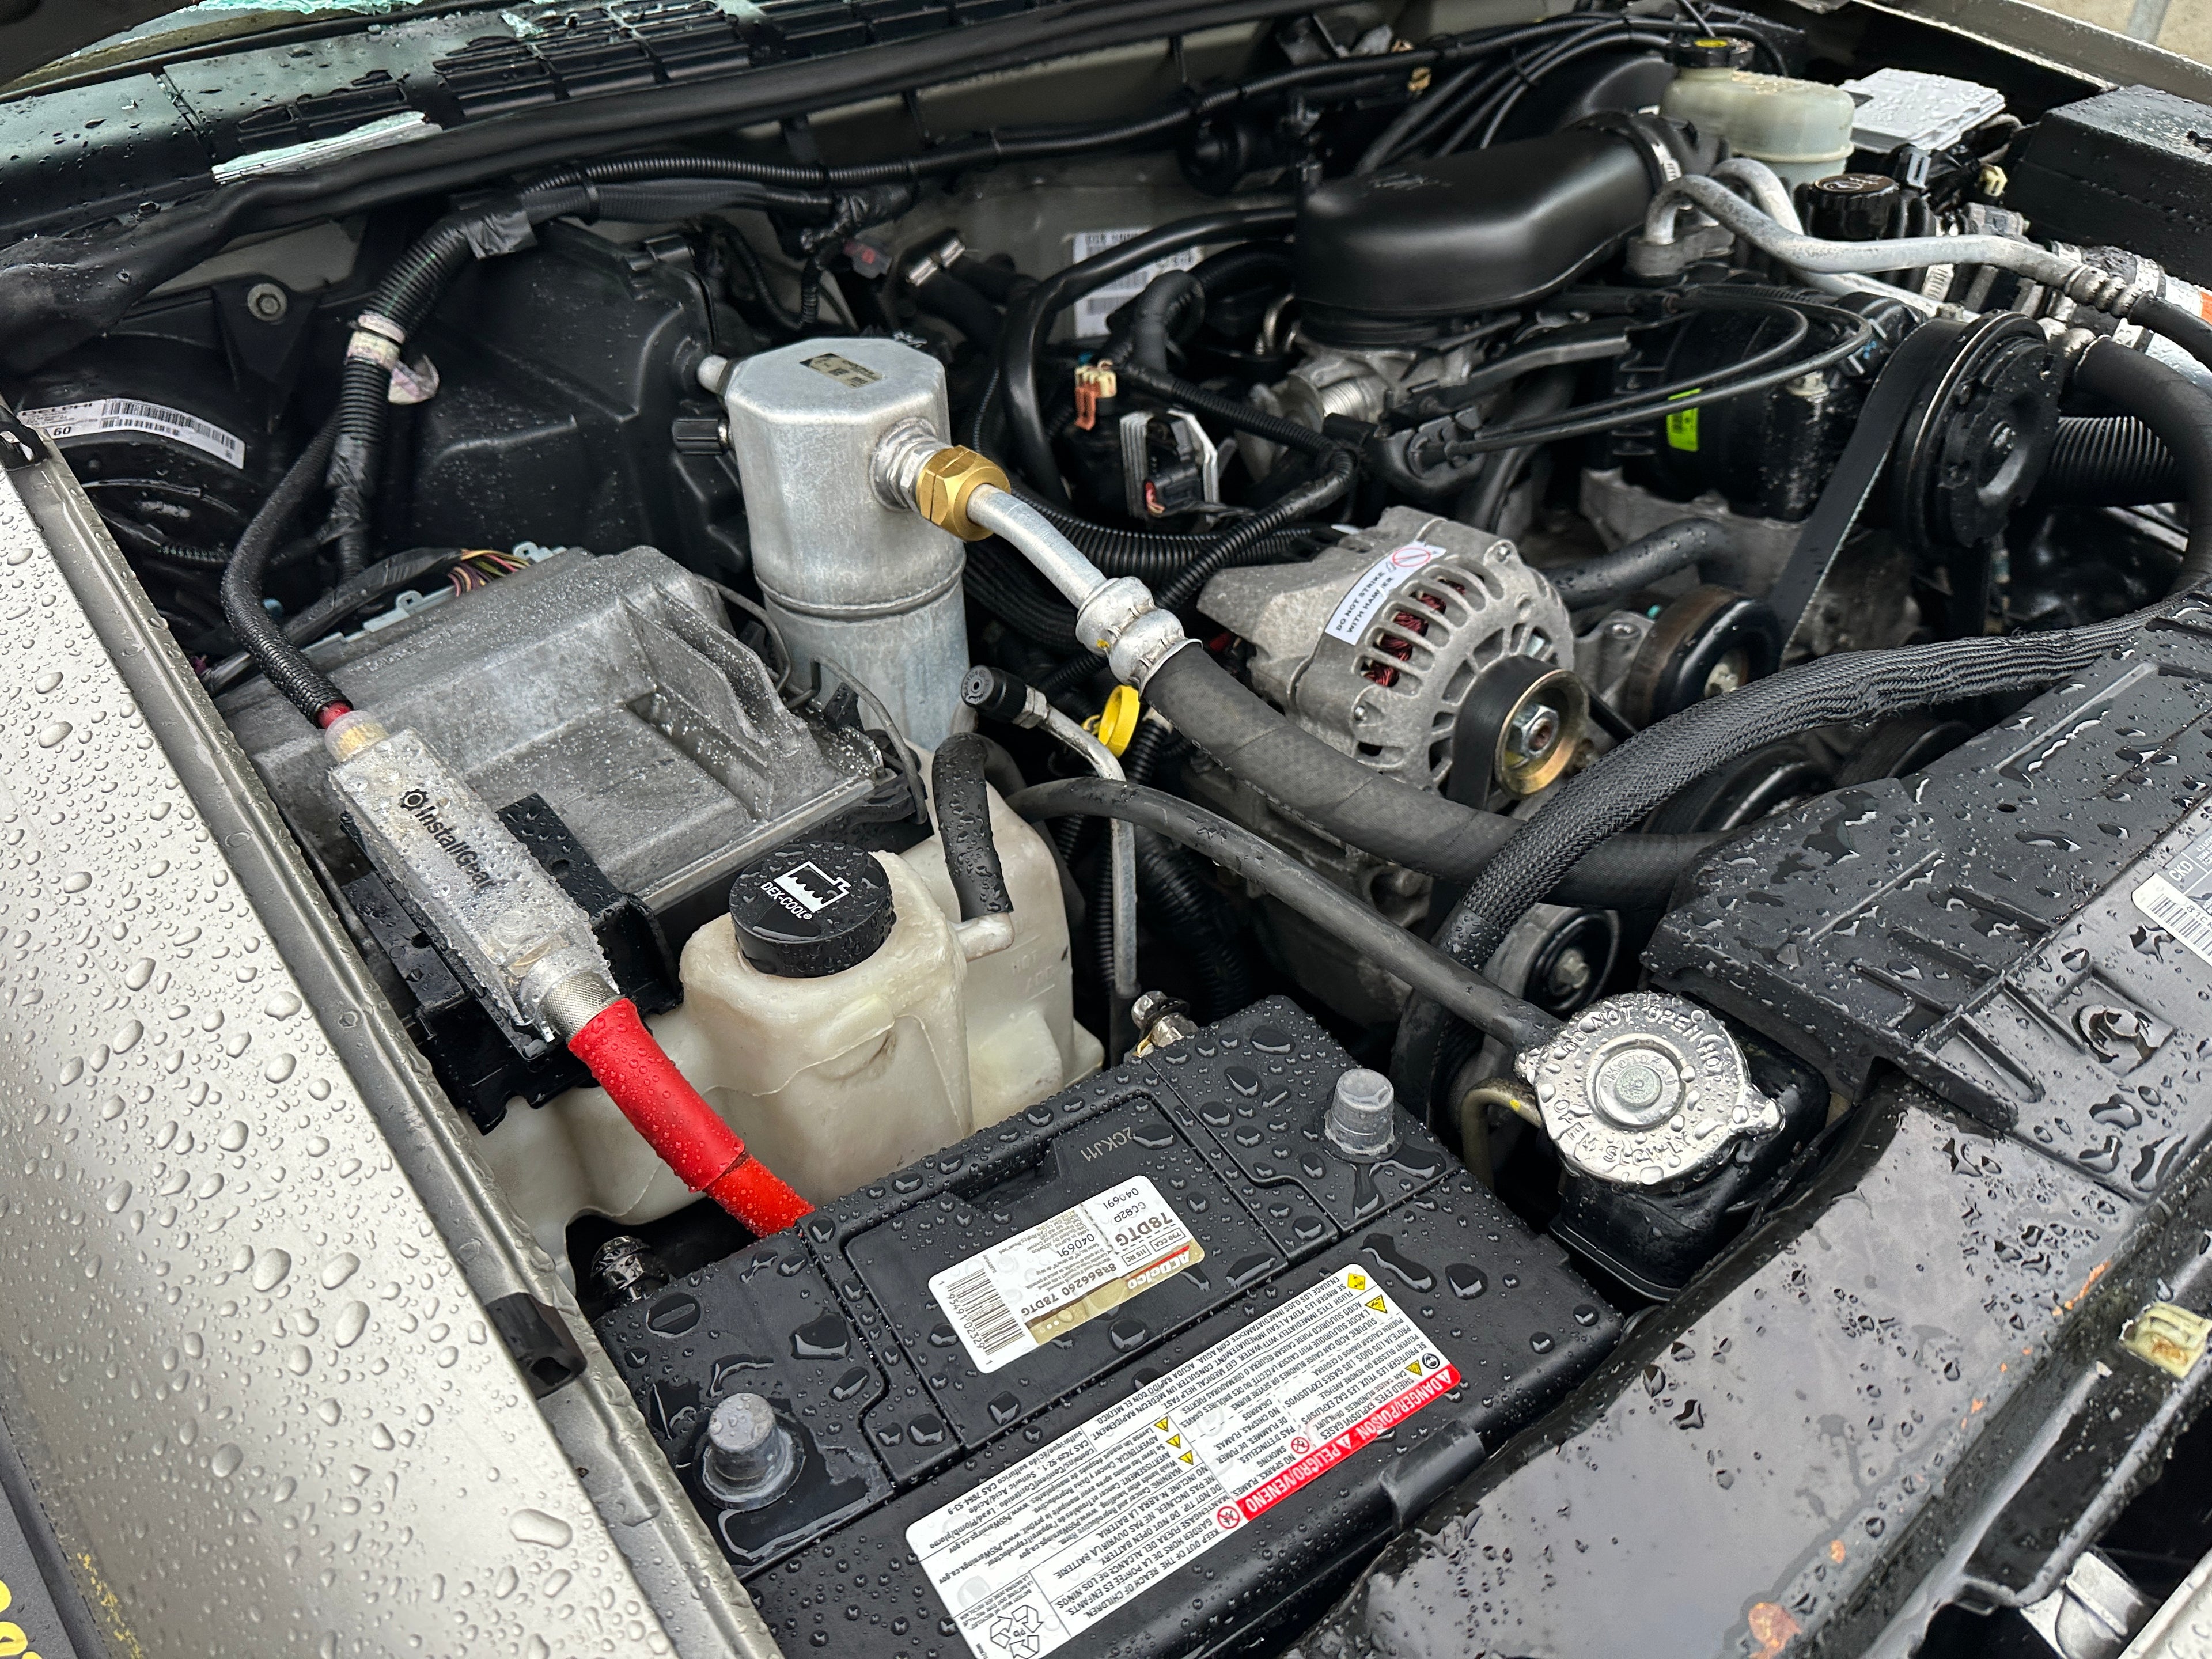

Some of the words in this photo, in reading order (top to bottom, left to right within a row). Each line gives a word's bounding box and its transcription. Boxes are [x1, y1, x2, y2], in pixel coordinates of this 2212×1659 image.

[53, 426, 71, 436] 60
[1336, 618, 1346, 631] DO
[1344, 599, 1361, 617] NOT
[1358, 571, 1385, 597] STRIKE
[1347, 610, 1365, 634] WITH
[415, 805, 499, 890] InstallGear
[2169, 861, 2194, 881] CKD
[1591, 1005, 1634, 1028] NOT
[1080, 1126, 1132, 1162] 2CKJ11
[1103, 1188, 1139, 1210] 040691
[1115, 1212, 1173, 1247] 78DTG
[1168, 1232, 1181, 1241] 790
[1056, 1233, 1095, 1257] 040691
[1153, 1238, 1168, 1247] CCA
[1126, 1254, 1137, 1262] RC
[1135, 1249, 1147, 1257] 115
[1127, 1251, 1190, 1289] ACDelco
[1062, 1263, 1117, 1296] 88866260
[1311, 1276, 1340, 1296] ENJUAGE
[1336, 1283, 1346, 1291] SE
[1300, 1292, 1313, 1302] LOS
[1315, 1288, 1339, 1304] RINSER
[1333, 1290, 1353, 1305] FLUSH
[946, 1293, 968, 1320] 95491
[1021, 1293, 1059, 1316] 78DTG
[1283, 1299, 1301, 1312] OJOS
[1304, 1301, 1317, 1311] LES
[1316, 1302, 1334, 1315] EYES
[1282, 1316, 1290, 1325] À
[1288, 1308, 1306, 1321] YEUX
[1346, 1309, 1370, 1327] L'ACIDE
[1266, 1320, 1285, 1335] L'EAU
[1278, 1312, 1319, 1339] IMMEDIATELY
[1349, 1317, 1378, 1338] SULFURIC
[964, 1321, 985, 1349] 02329
[1294, 1330, 1313, 1345] PUEDE
[1310, 1322, 1349, 1348] SULFURIQUE
[1334, 1334, 1350, 1346] ACID
[1360, 1330, 1383, 1346] CAUSAR
[1383, 1325, 1412, 1344] PROTEJA
[1216, 1340, 1231, 1353] CON
[1272, 1341, 1296, 1358] CAUSAR
[1298, 1343, 1313, 1356] PEUT
[1322, 1343, 1336, 1354] CAN
[1342, 1342, 1363, 1358] DAÑOS
[1372, 1340, 1386, 1353] LOS
[1395, 1334, 1420, 1352] PEUVENT
[1416, 1342, 1427, 1351] SE
[1196, 1349, 1217, 1363] AGUA.
[1236, 1344, 1264, 1361] WATER.
[1277, 1352, 1300, 1368] CAUSER
[1304, 1350, 1324, 1365] CAUSE
[1353, 1349, 1374, 1362] OJOS.
[1372, 1348, 1397, 1366] BLESSER
[1387, 1346, 1419, 1370] PROTÉGER
[1171, 1362, 1195, 1379] ACUDA
[1225, 1359, 1238, 1372] GET
[1311, 1357, 1339, 1376] CEGUERA.
[1342, 1359, 1356, 1372] LOS
[1364, 1362, 1374, 1372] OU
[1376, 1365, 1389, 1377] LES
[1176, 1363, 1214, 1388] CONSULTER
[1195, 1368, 1226, 1388] MEDICAL
[1270, 1377, 1280, 1386] OR
[1321, 1368, 1344, 1384] GASES
[1342, 1368, 1366, 1385] RENDRE
[1358, 1373, 1378, 1388] YEUX.
[1165, 1385, 1177, 1396] UN
[1181, 1385, 1198, 1399] HELP
[1250, 1382, 1272, 1399] SEVERE
[1346, 1384, 1361, 1396] LES
[1391, 1377, 1415, 1393] SHIELD
[1132, 1391, 1149, 1403] CON
[1284, 1380, 1324, 1408] EXPLOSIVOS
[1333, 1392, 1349, 1404] GAZ
[1374, 1389, 1394, 1404] EYES.
[1123, 1400, 1134, 1408] EL
[1161, 1395, 1181, 1410] FAST.
[1180, 1395, 1207, 1414] FUERTES.
[1229, 1395, 1252, 1411] BURNS.
[1241, 1398, 1273, 1421] CIGARROS
[1351, 1377, 1443, 1440] DANGER/POISON
[1268, 1407, 1281, 1418] NO
[1301, 1400, 1336, 1425] EXPLOSIFS
[1240, 1414, 1269, 1433] CHISPAS,
[1277, 1416, 1288, 1426] DE
[1246, 1422, 1279, 1445] FLAMMES,
[1279, 1425, 1296, 1438] PAS
[1073, 1440, 1089, 1452] CAS
[1213, 1431, 1243, 1450] FLAMAS,
[1215, 1447, 1240, 1464] FUMER
[1256, 1445, 1287, 1468] SMOKING
[1283, 1453, 1296, 1464] NO
[1195, 1465, 1209, 1476] NO
[1240, 1443, 1341, 1512] PELIGRO/VENENO
[1256, 1460, 1285, 1480] SPARKS,
[981, 1482, 998, 1495] CAS
[1168, 1473, 1197, 1494] INCLINE
[1188, 1482, 1206, 1494] PAS
[1203, 1475, 1216, 1486] NE
[1210, 1483, 1222, 1494] DO
[1230, 1477, 1259, 1497] FLAMES,
[1099, 1482, 1121, 1498] Cancer
[1129, 1486, 1151, 1502] Cancer
[1195, 1490, 1211, 1505] NOT
[1116, 1499, 1129, 1511] and
[1137, 1495, 1160, 1512] ABRA
[1181, 1501, 1196, 1512] TIP.
[1127, 1508, 1139, 1519] LA
[1142, 1511, 1156, 1524] NE
[1169, 1510, 1181, 1521] DO
[1095, 1516, 1130, 1539] BATERÍA.
[1128, 1520, 1145, 1533] PAS
[1153, 1517, 1170, 1532] NOT
[1183, 1518, 1213, 1541] GARDER
[1101, 1529, 1129, 1550] OUVRIR
[1132, 1527, 1153, 1544] OPEN
[1156, 1525, 1181, 1544] FUERA
[1202, 1528, 1221, 1544] KEEP
[1089, 1546, 1104, 1556] LA
[1099, 1540, 1134, 1566] BATTERY.
[1142, 1540, 1158, 1553] DEL
[1162, 1537, 1184, 1555] HORS
[1185, 1540, 1202, 1554] OUT
[1108, 1550, 1143, 1574] ALCANCE
[1141, 1557, 1153, 1567] LA
[1151, 1550, 1164, 1562] DE
[1159, 1557, 1176, 1570] THE
[1176, 1550, 1187, 1561] OF
[1053, 1552, 1092, 1580] BATTERIE.
[1082, 1577, 1099, 1592] LOS
[1133, 1567, 1160, 1588] REACH
[1124, 1583, 1135, 1595] OF
[1054, 1588, 1083, 1609] NIÑOS.
[1065, 1588, 1104, 1616] ENFANTS.
[1083, 1590, 1124, 1619] CHILDREN.
[1013, 1629, 1027, 1638] Pb
